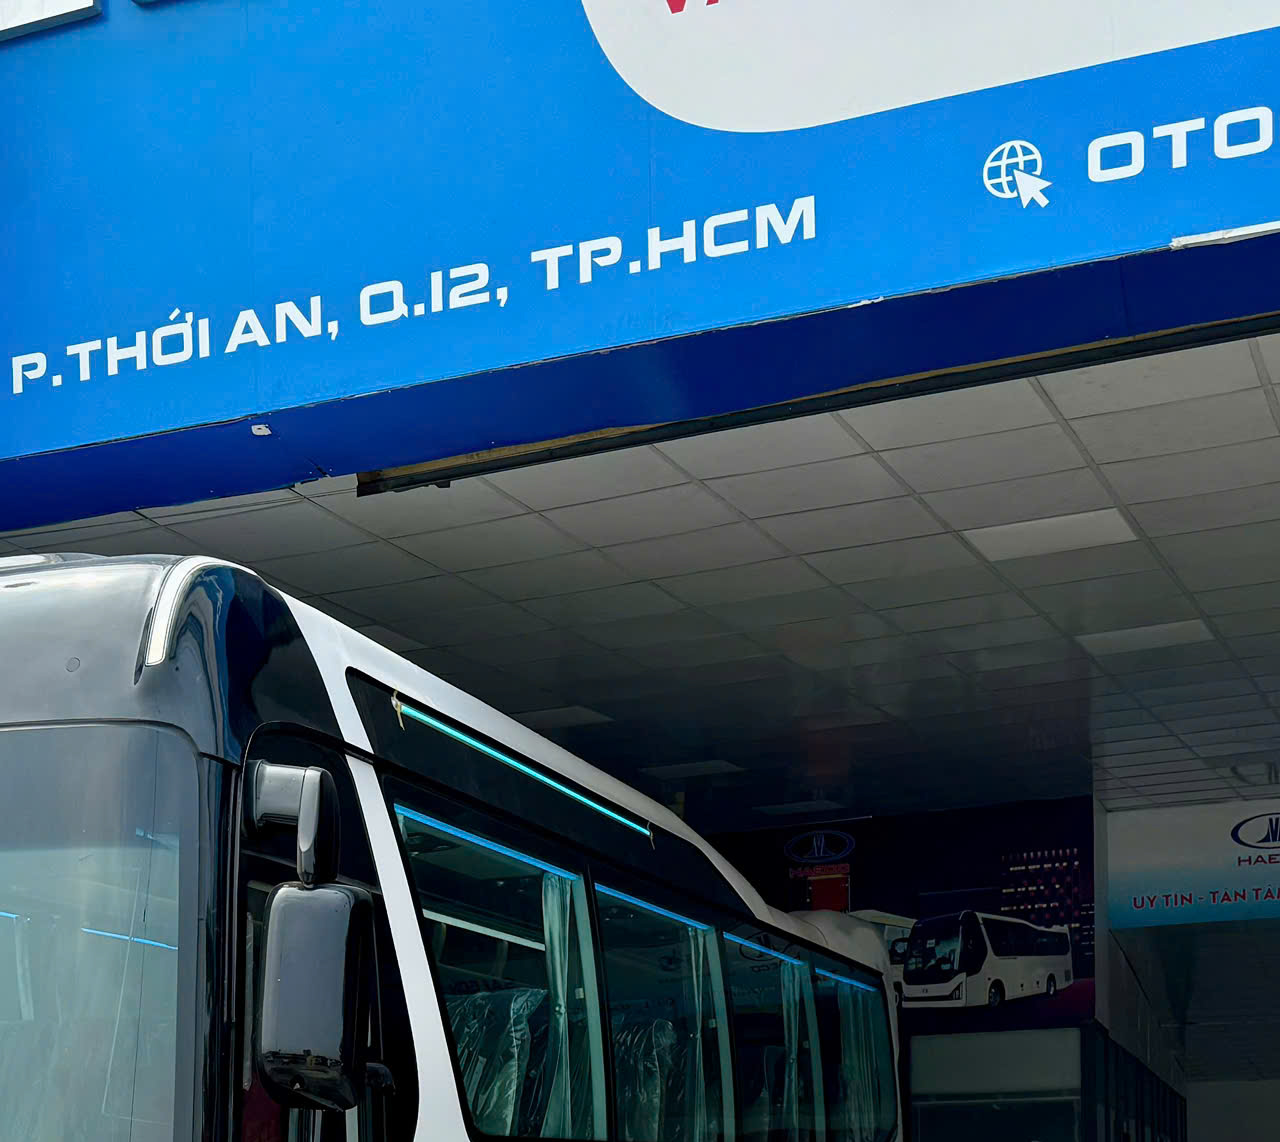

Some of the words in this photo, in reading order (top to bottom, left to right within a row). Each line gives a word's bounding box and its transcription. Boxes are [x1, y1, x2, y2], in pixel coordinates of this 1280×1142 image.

[11, 307, 210, 395] P.THỚI
[224, 294, 341, 354] AN,
[530, 194, 818, 291] TP.HCM
[1133, 895, 1158, 909] UY
[1252, 884, 1280, 900] TÂ
